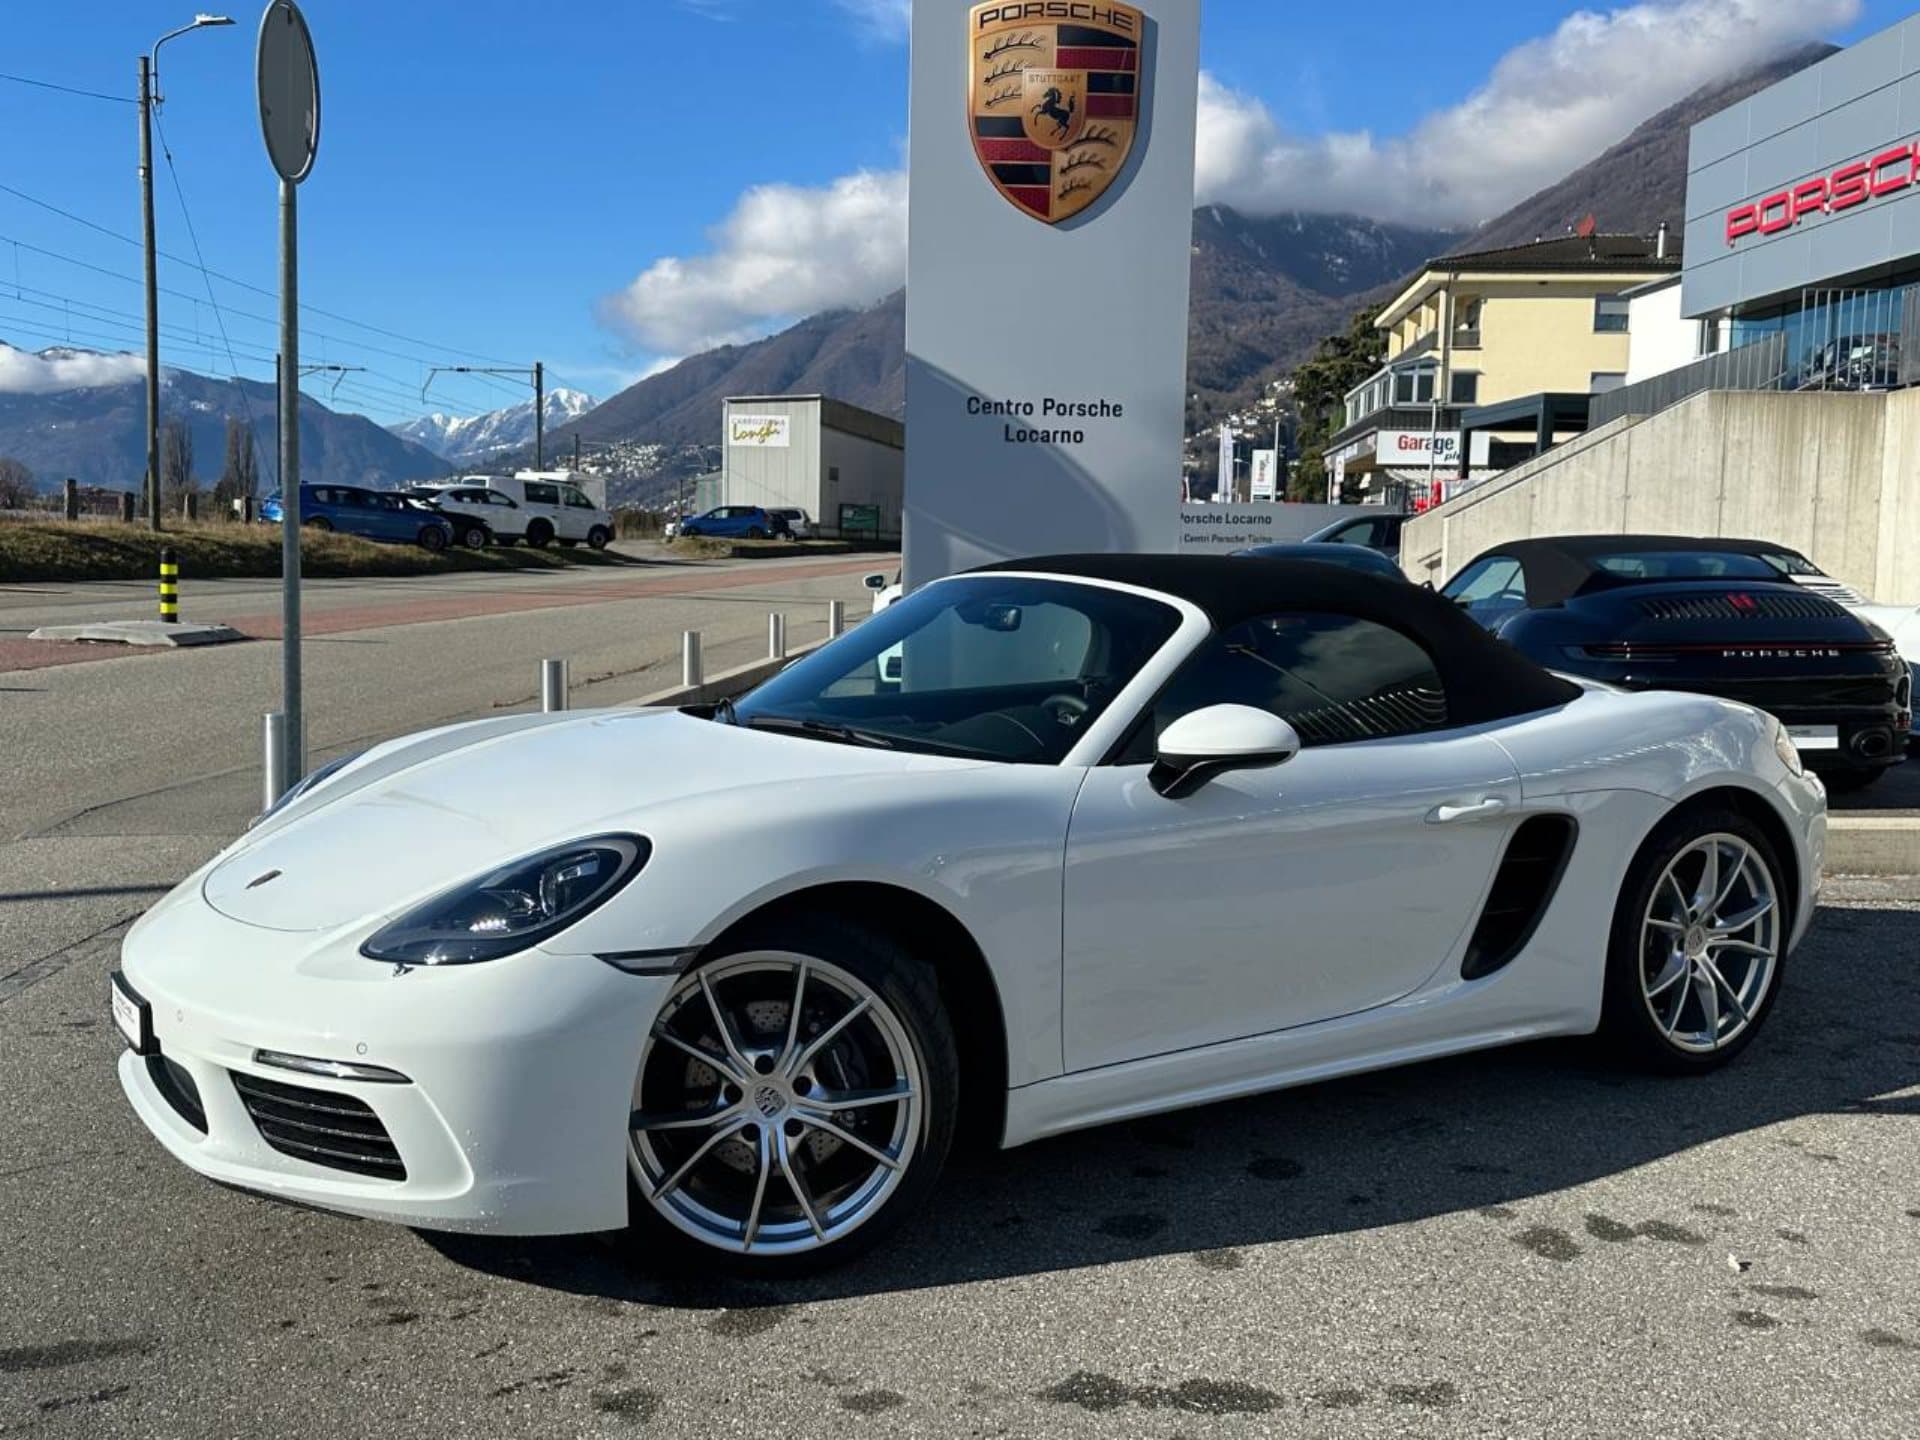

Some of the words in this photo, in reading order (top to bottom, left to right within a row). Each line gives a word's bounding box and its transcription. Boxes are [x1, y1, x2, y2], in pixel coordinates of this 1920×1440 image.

[980, 2, 1133, 31] PORSCHE
[1726, 141, 1920, 247] PORSC
[967, 396, 1034, 416] Centro
[1043, 398, 1124, 418] Porsche
[1005, 424, 1084, 443] Locarno
[1398, 435, 1454, 454] Garage
[1225, 512, 1272, 525] Locarno
[1723, 649, 1840, 658] PORSCHE
